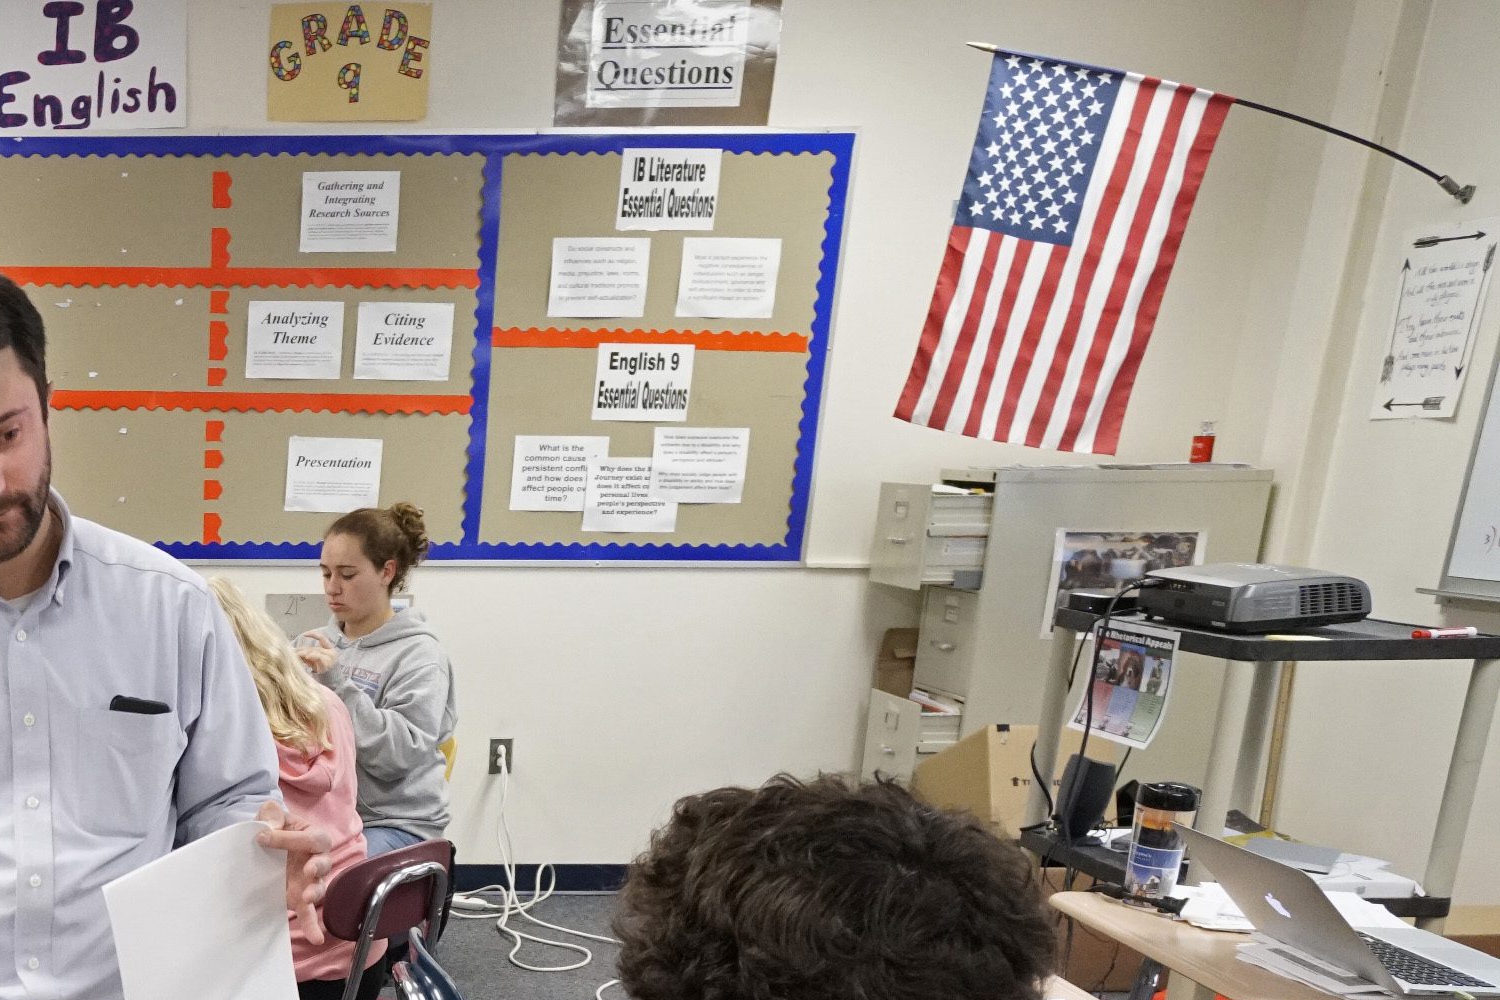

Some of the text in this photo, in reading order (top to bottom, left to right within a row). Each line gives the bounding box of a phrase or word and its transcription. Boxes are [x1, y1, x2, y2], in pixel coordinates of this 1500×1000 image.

[37, 0, 140, 66] IB
[604, 16, 737, 44] Essential
[270, 5, 430, 82] GRADE
[337, 62, 362, 103] 9
[597, 60, 734, 89] Questions
[633, 157, 706, 182] IB Literature
[317, 181, 384, 192] Gathering and
[324, 195, 376, 206] Integrating
[621, 188, 715, 219] Essential Questions
[309, 209, 390, 218] Research Sources
[261, 312, 329, 328] Analyzing
[384, 313, 426, 329] Citing
[272, 331, 317, 345] Theme
[372, 332, 434, 346] Evidence
[609, 352, 680, 375] English 9
[597, 381, 687, 411] Essential Questions
[295, 456, 372, 469] Presentation
[522, 465, 563, 473] persistent
[522, 485, 587, 493] affect people ov
[1099, 628, 1173, 650] Te Rhetorical Appeals
